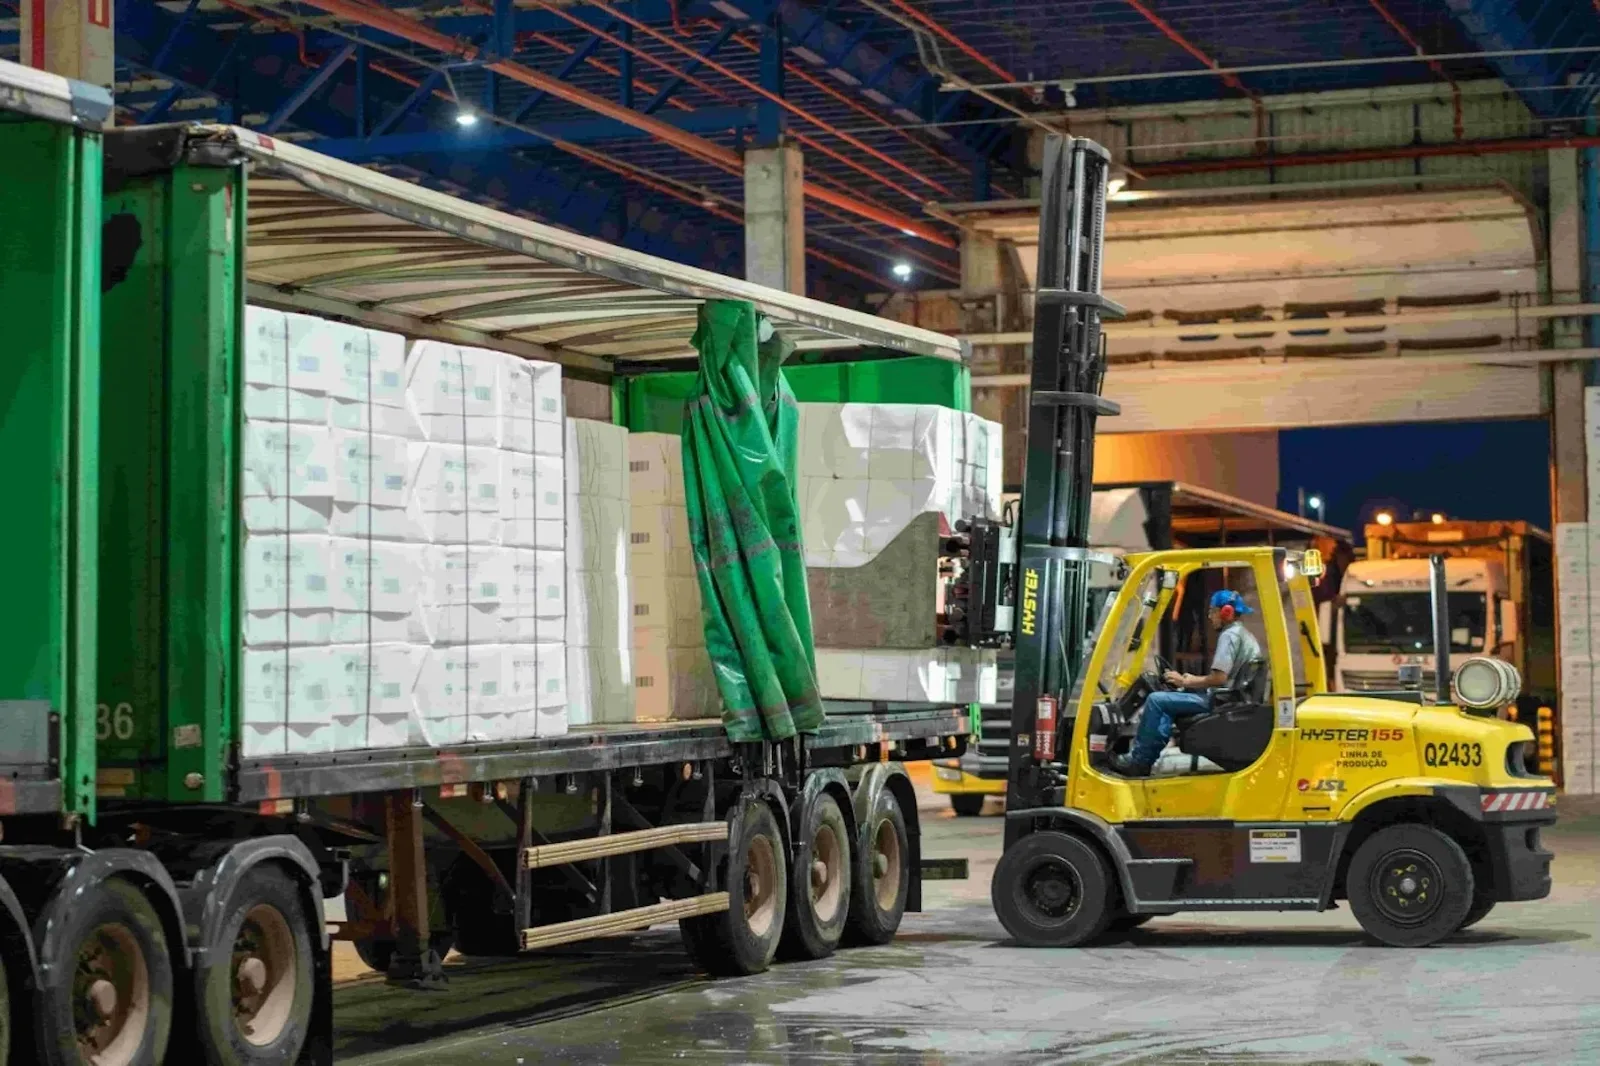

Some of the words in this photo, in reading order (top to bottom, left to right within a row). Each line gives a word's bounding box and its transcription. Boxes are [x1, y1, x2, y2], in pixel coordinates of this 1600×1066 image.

[1300, 728, 1369, 741] HYSTER
[1371, 728, 1404, 741] 155
[1340, 750, 1368, 759] LINHA
[1371, 750, 1382, 758] DE
[1424, 742, 1482, 768] Q2433
[1336, 759, 1387, 769] PRODUÇÃO
